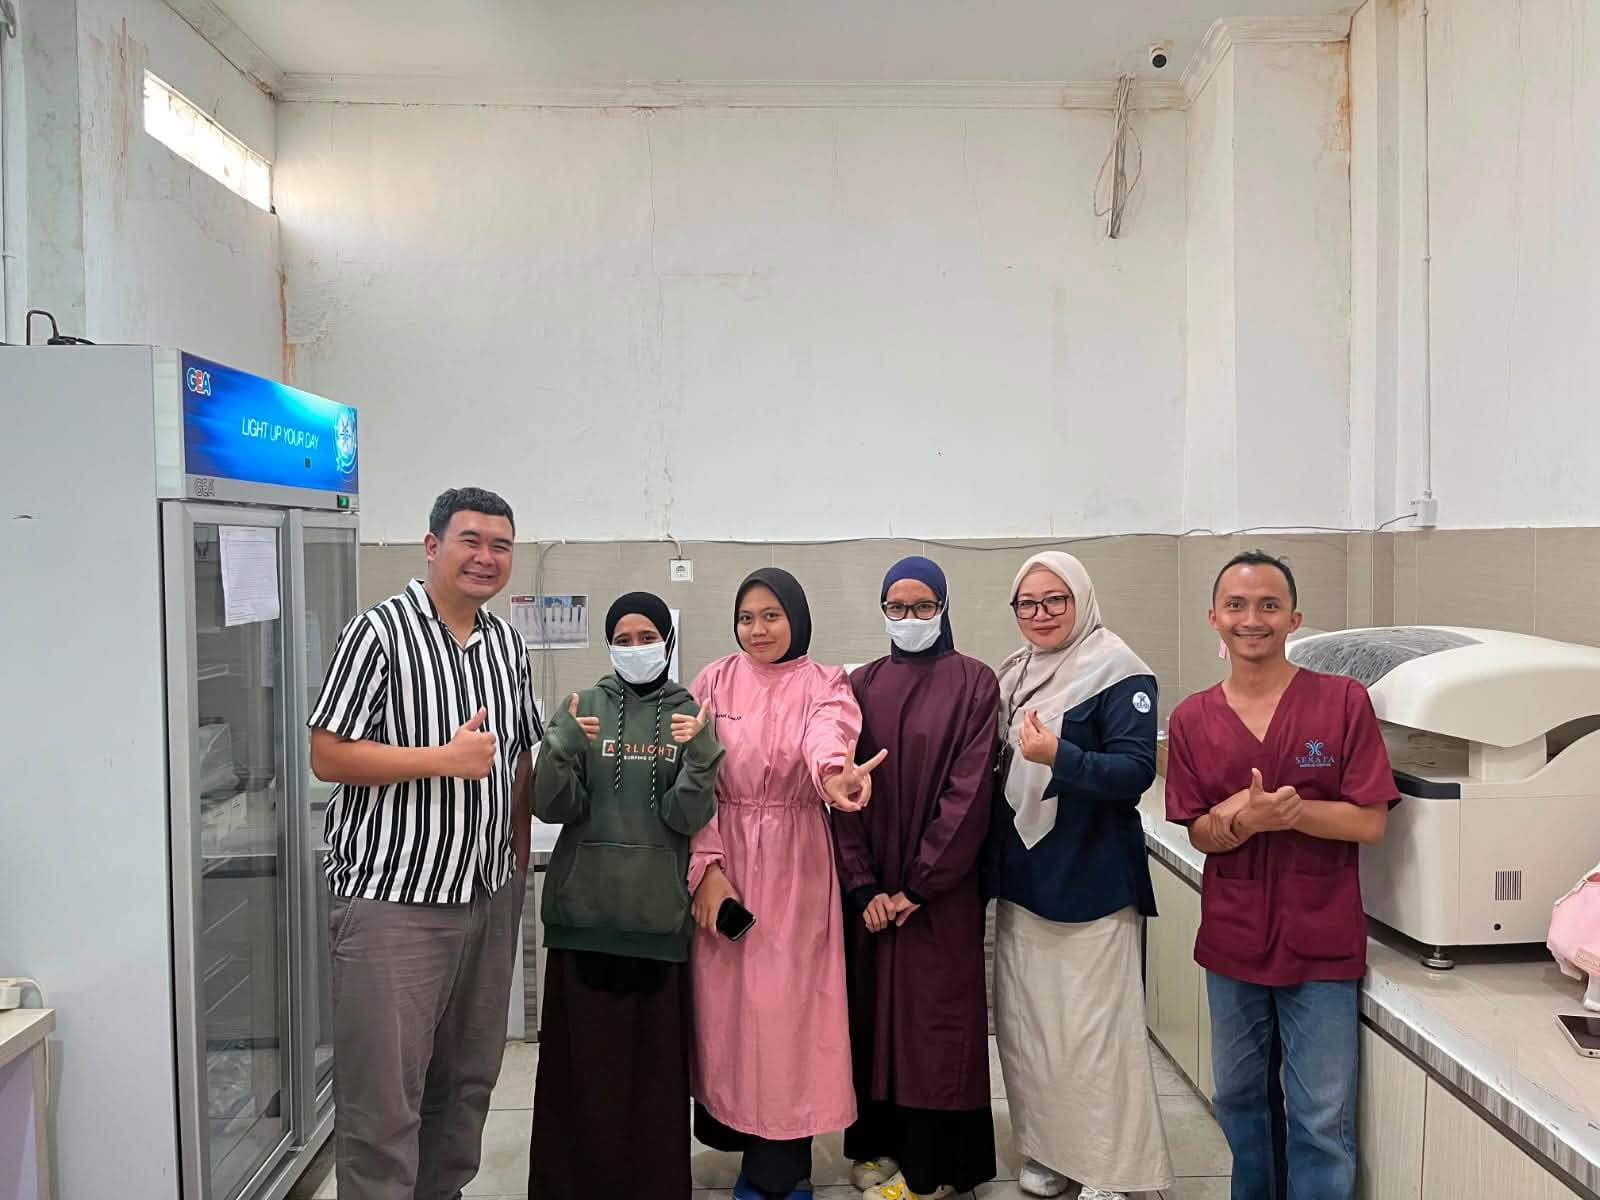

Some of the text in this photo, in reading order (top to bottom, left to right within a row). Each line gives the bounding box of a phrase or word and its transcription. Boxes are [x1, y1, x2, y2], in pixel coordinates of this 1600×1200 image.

[187, 368, 211, 396] GEA
[241, 416, 319, 449] LIGHT UP YOUR DAY
[607, 743, 673, 757] ARLIGHT
